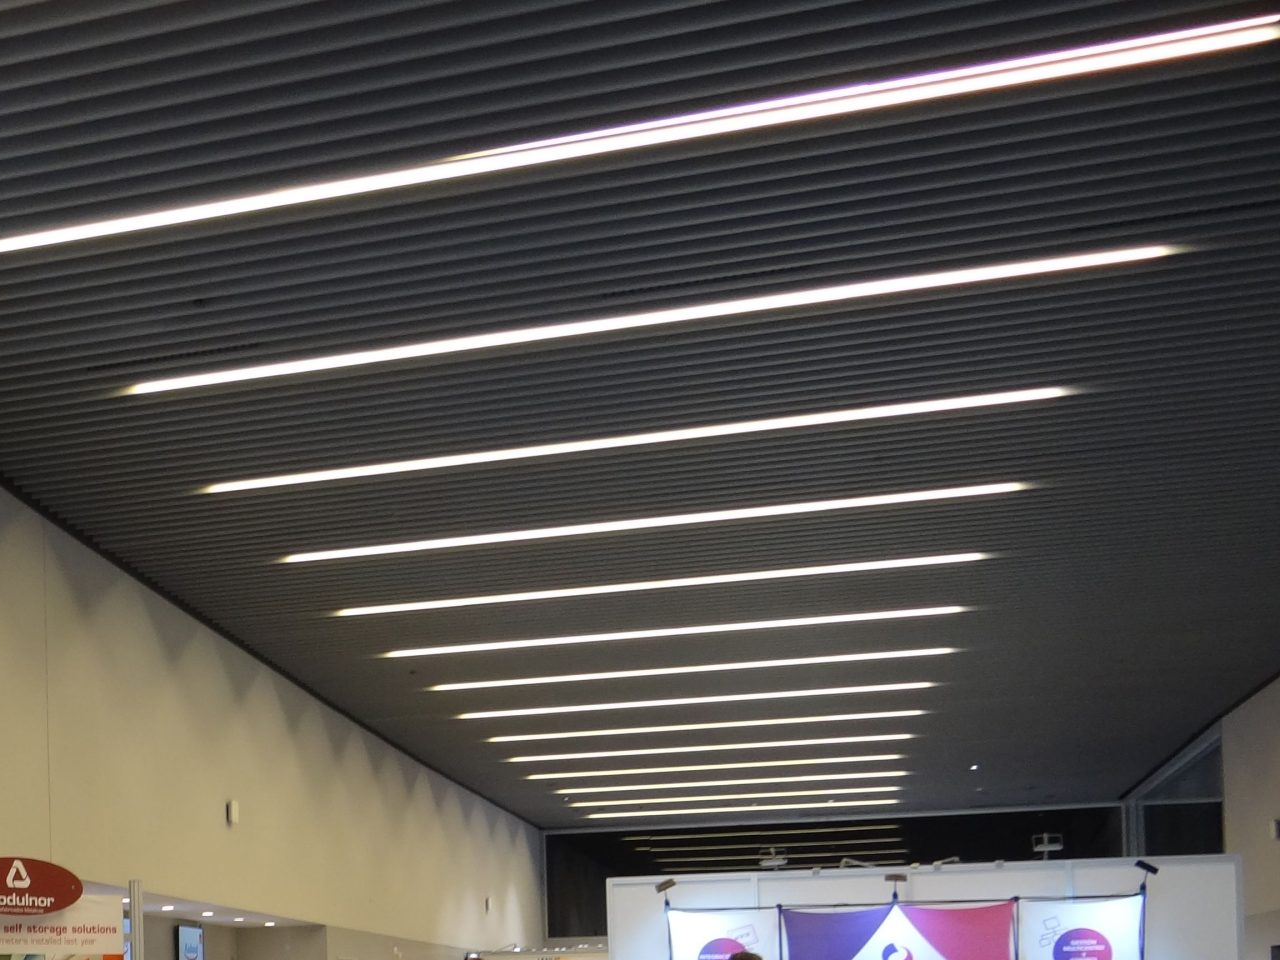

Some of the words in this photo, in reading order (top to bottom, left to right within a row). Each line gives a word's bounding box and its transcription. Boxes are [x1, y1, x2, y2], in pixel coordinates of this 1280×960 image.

[4, 923, 22, 934] self
[27, 924, 68, 936] storage
[71, 924, 117, 934] solutions
